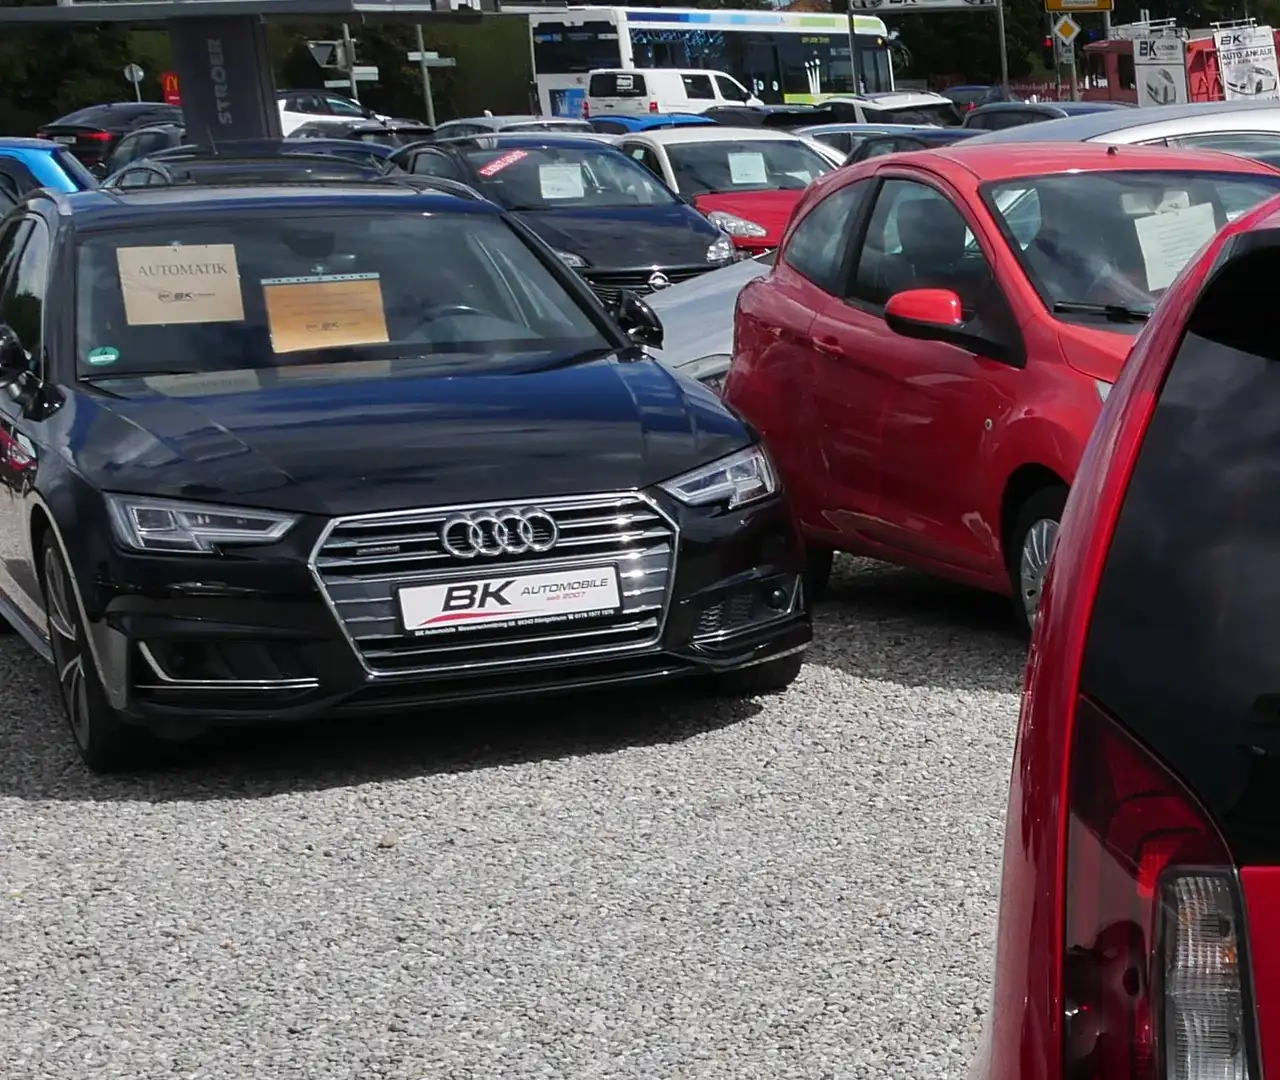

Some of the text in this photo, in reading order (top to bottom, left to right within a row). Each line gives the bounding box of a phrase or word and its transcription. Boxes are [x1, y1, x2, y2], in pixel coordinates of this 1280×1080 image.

[1139, 40, 1157, 57] BK
[138, 263, 228, 277] AUTOMATIK
[442, 578, 609, 612] BK AUTOMOBILE
[562, 591, 586, 600] 2007
